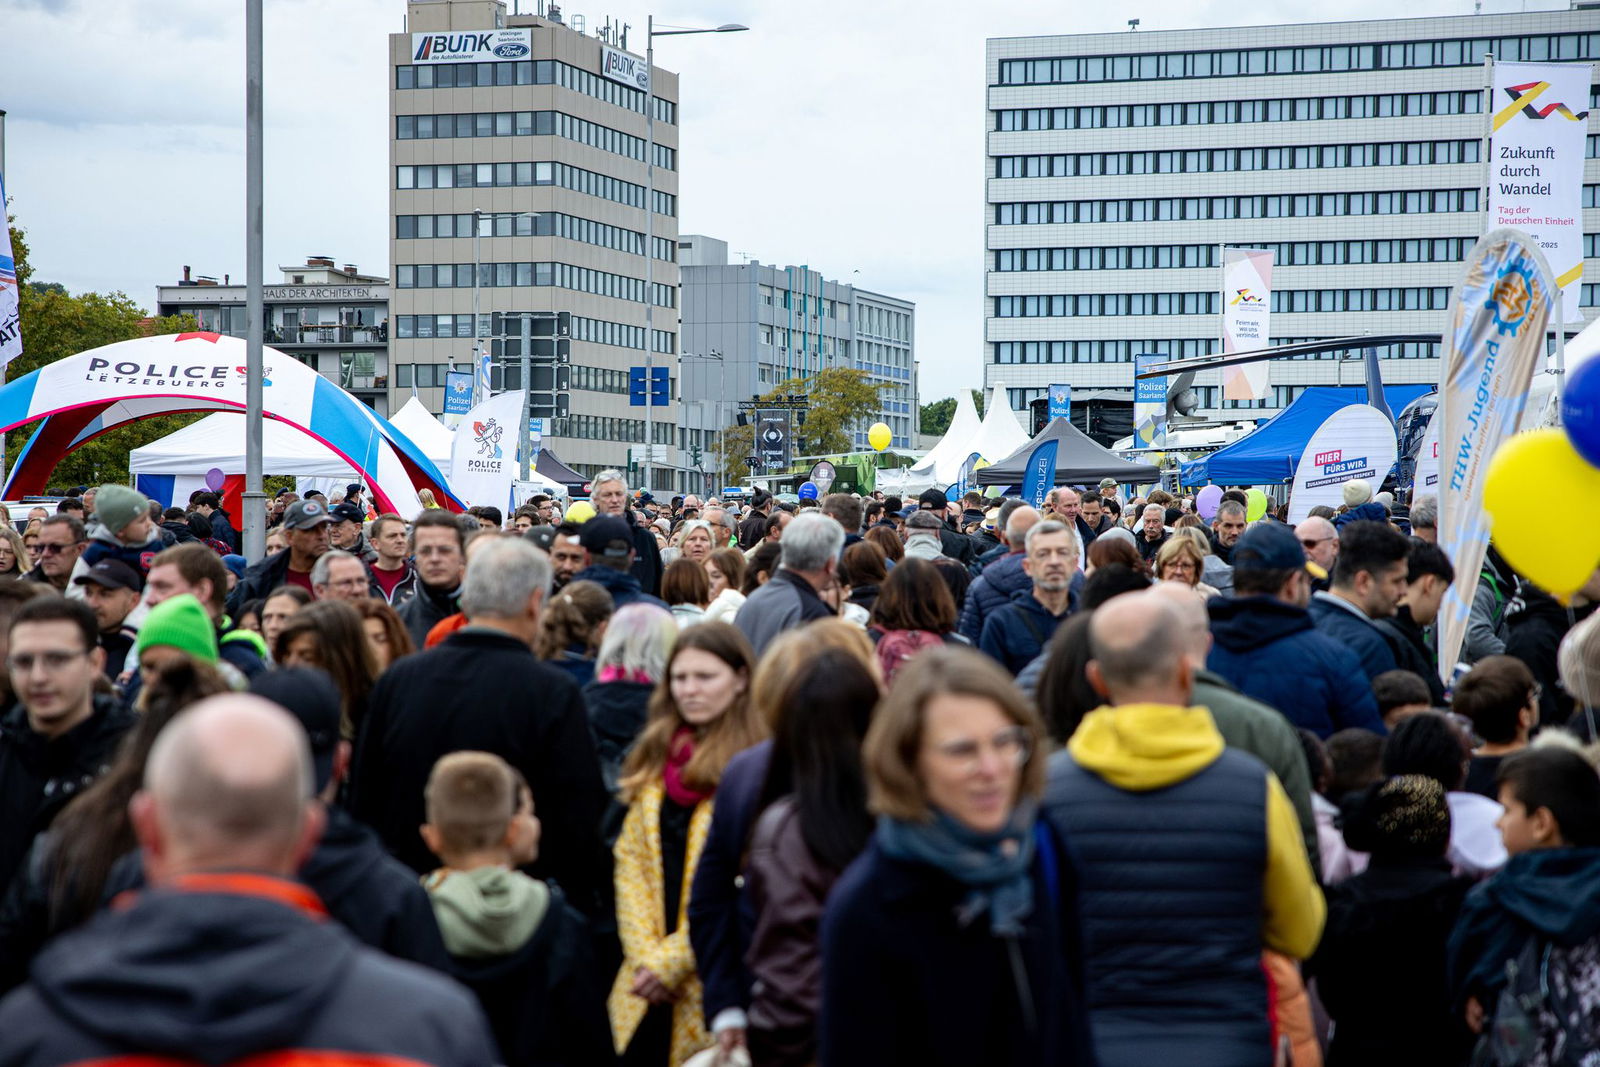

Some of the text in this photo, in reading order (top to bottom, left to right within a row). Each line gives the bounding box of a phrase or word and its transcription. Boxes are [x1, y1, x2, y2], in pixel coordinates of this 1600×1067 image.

[432, 33, 493, 53] BUNK
[611, 53, 635, 77] BUNK
[1500, 146, 1556, 159] Zukunft
[1500, 164, 1541, 177] durch
[1499, 183, 1551, 195] Wandel
[1498, 206, 1531, 215] Tag der
[1498, 217, 1574, 226] Deutschen Einheit
[263, 288, 369, 299] HAUS DER ARCHITEKTEN
[89, 357, 229, 379] POLICE
[86, 372, 225, 388] LËTZEBUERG
[1138, 382, 1166, 391] Polizei
[447, 396, 471, 404] Polizei
[1450, 339, 1500, 492] THW-Jugend
[468, 460, 502, 469] POLICE
[1316, 453, 1340, 465] HIER
[1325, 460, 1366, 474] FÜRS WIR.
[1035, 458, 1047, 510] ESPOLIZEI
